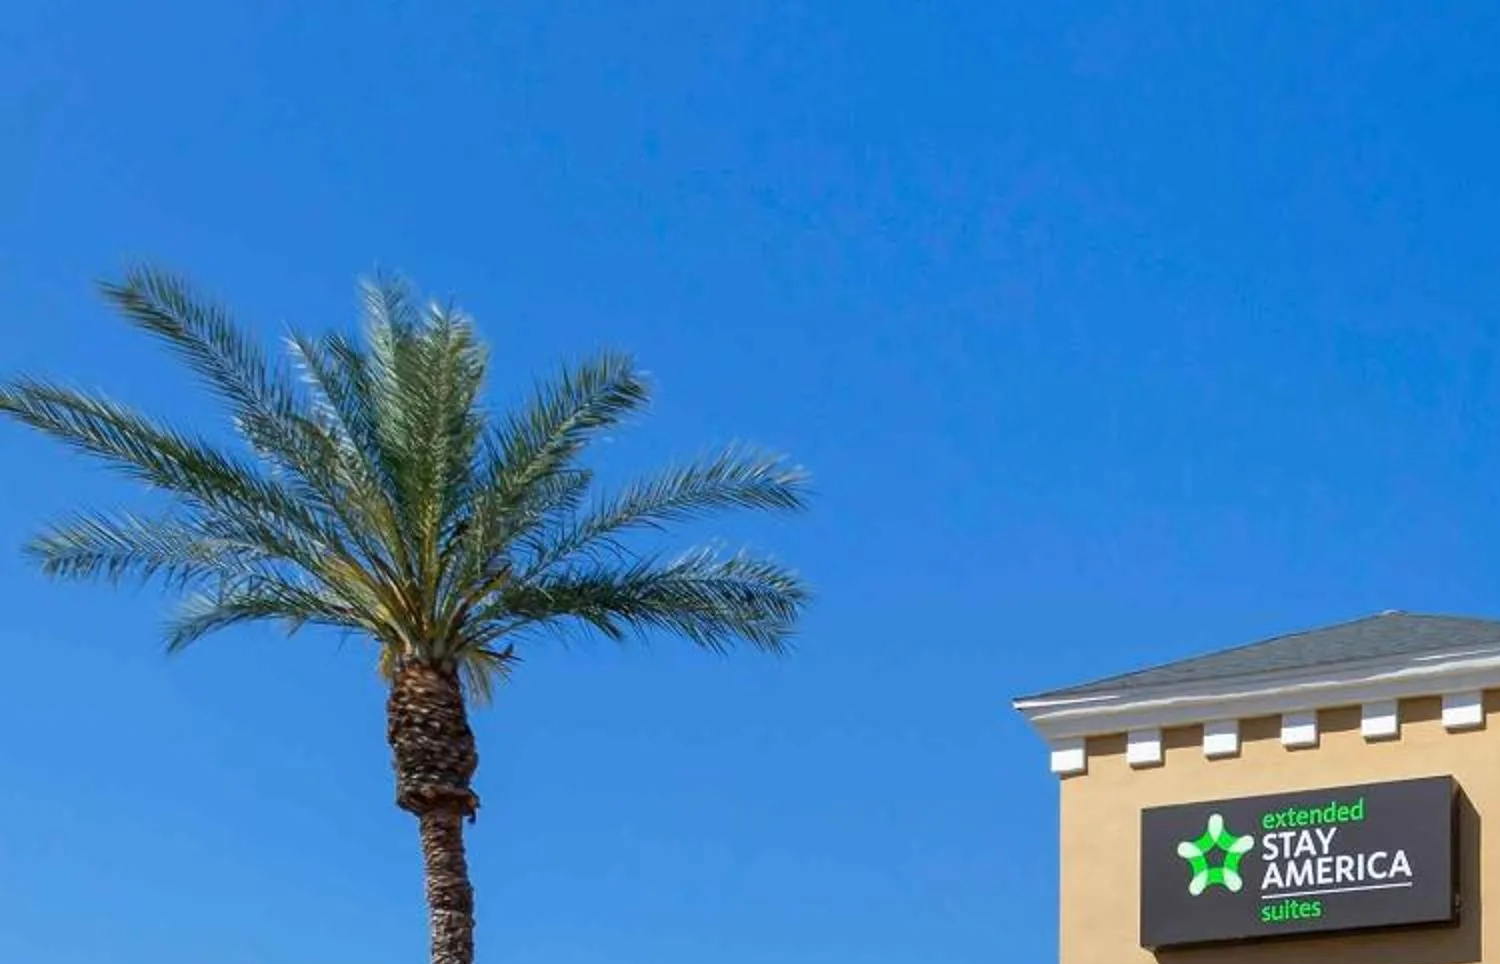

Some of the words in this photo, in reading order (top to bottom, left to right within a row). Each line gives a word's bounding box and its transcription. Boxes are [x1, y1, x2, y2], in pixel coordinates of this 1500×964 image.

[1262, 797, 1365, 829] extended
[1262, 827, 1337, 861] STAY
[1261, 849, 1412, 890] AMERICA
[1261, 899, 1322, 922] suites
